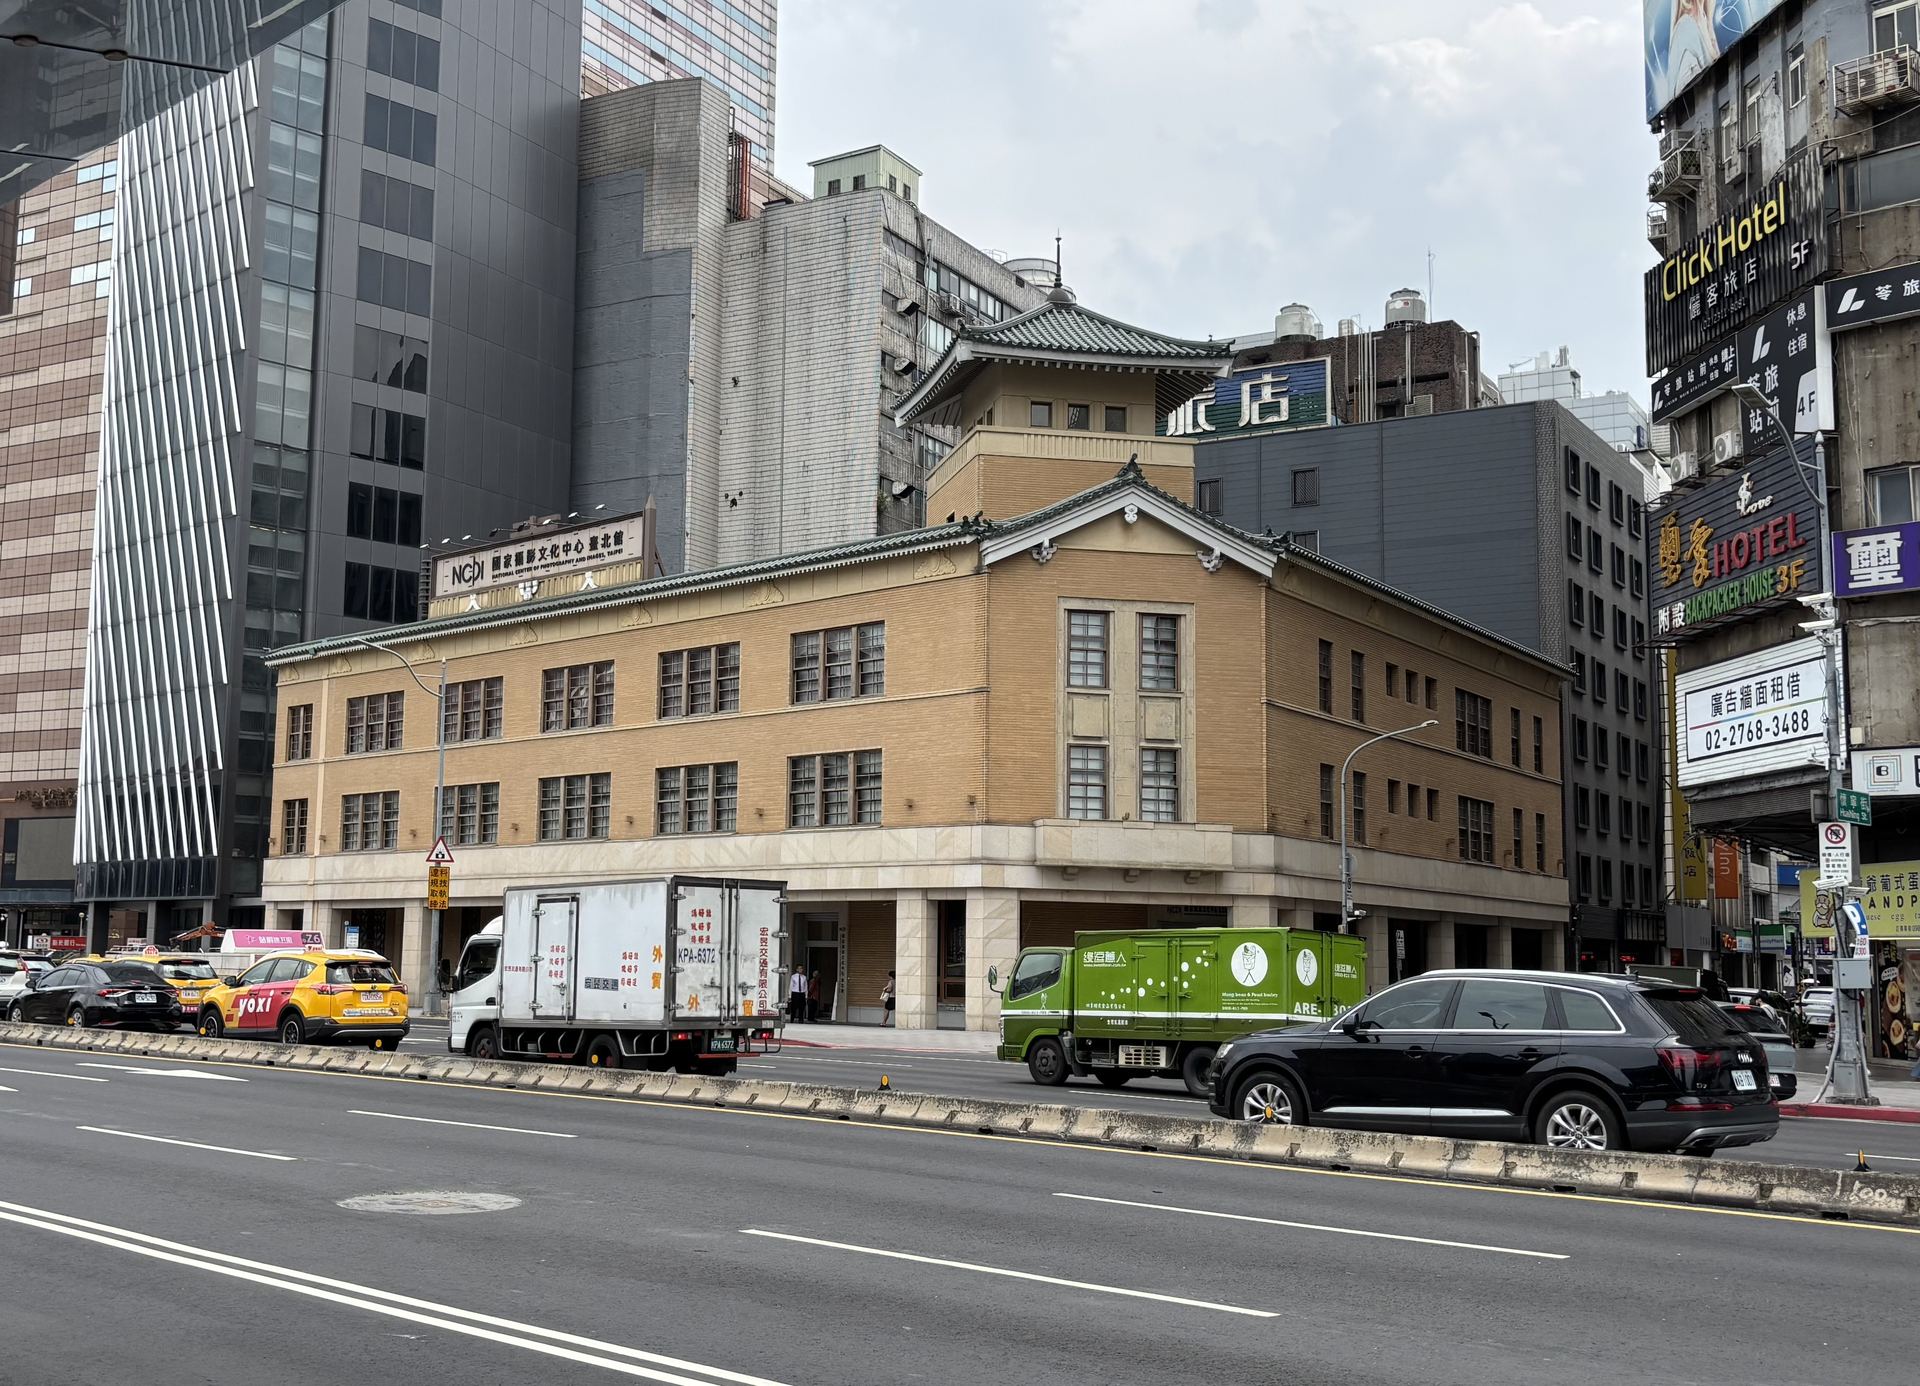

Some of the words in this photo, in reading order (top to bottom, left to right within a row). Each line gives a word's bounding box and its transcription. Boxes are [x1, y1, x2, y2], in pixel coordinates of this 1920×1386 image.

[1662, 238, 1713, 301] Click
[1716, 181, 1786, 266] Hotel
[1790, 239, 1811, 271] 5F
[1689, 257, 1757, 320] 儷客旅店
[1786, 302, 1807, 327] 休息
[1787, 332, 1808, 358] 住宿
[1797, 390, 1816, 416] 4F
[1713, 512, 1806, 578] HOTEL
[492, 571, 514, 580] NATIONAL
[515, 566, 533, 575] CENTER
[540, 559, 575, 570] PHOTOGRAPHY
[607, 547, 624, 557] TAIPEI
[1776, 559, 1805, 594] 3F
[1685, 580, 1741, 625] BACKPACKER
[1743, 568, 1776, 604] HOUSE
[1658, 601, 1685, 635] 附設
[1711, 671, 1801, 718] 廣告牆面租借
[1705, 709, 1810, 751] 02-2768-3488
[678, 948, 716, 964] KPA-6372
[239, 989, 275, 1018] yoxi
